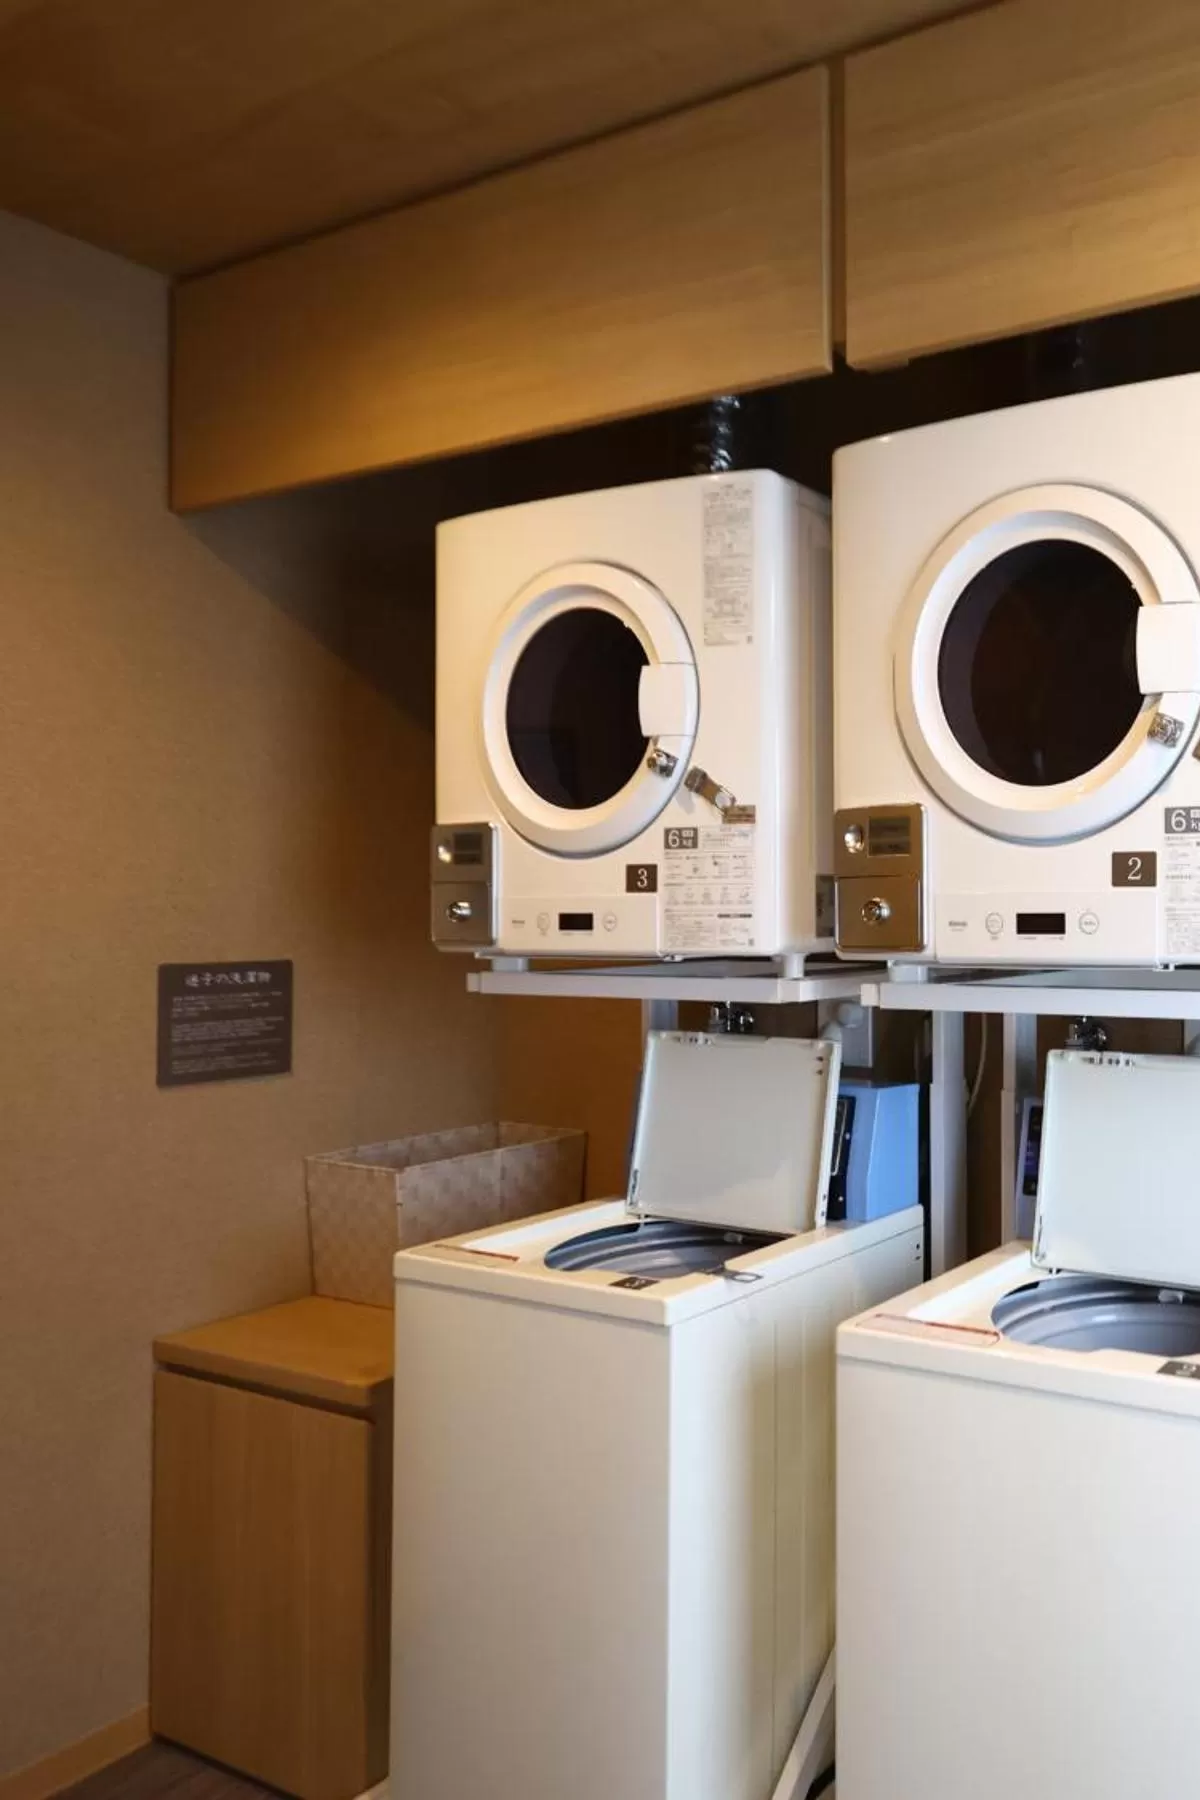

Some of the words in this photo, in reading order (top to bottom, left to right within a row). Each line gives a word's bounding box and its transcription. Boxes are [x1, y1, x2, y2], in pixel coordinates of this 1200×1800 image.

[1170, 808, 1187, 832] 6
[667, 829, 680, 848] 6
[636, 868, 648, 888] 3
[1126, 857, 1143, 880] 2
